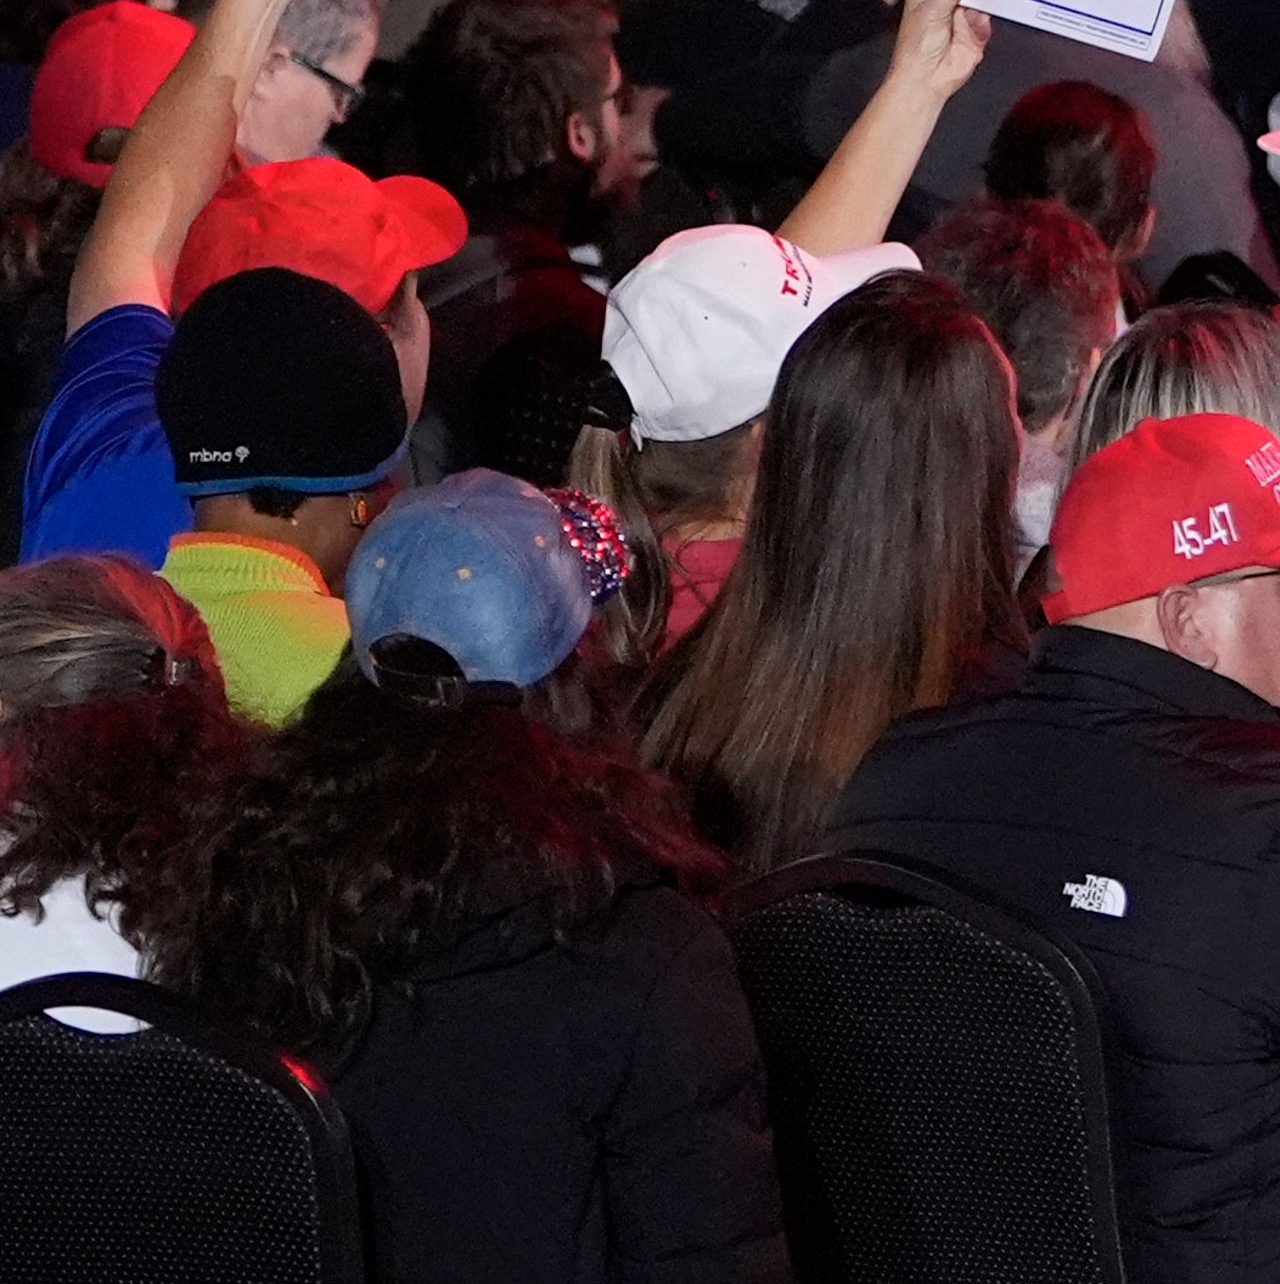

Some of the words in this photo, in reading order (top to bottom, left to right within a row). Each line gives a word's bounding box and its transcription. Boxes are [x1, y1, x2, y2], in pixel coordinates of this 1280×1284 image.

[189, 447, 233, 463] mbna
[1172, 502, 1240, 560] 45-47
[1085, 873, 1109, 889] THE
[1062, 882, 1107, 903] NORTH
[1070, 895, 1103, 914] FACE
